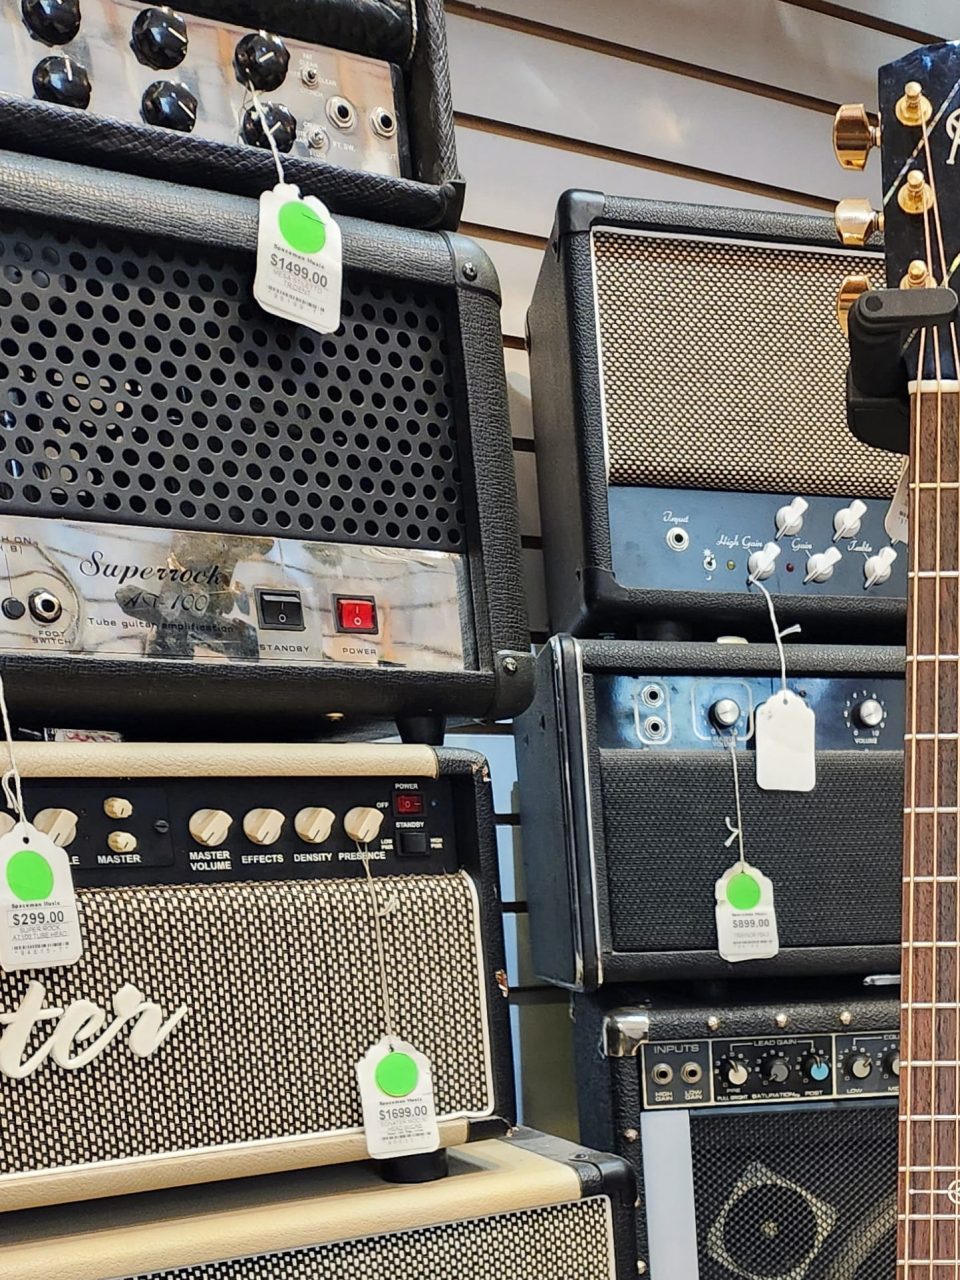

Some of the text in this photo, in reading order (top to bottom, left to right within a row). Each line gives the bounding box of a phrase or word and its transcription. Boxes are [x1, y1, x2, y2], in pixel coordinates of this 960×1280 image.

[270, 253, 328, 288] $1499.00
[717, 534, 763, 549] High Gain
[791, 537, 813, 549] Gain
[79, 550, 223, 585] Superrock
[88, 617, 235, 634] Tube guitar amplification
[38, 630, 66, 638] FOOT
[32, 637, 72, 645] SWITCH
[259, 643, 310, 653] STANDBY
[342, 647, 377, 655] POWER
[97, 854, 142, 864] MASTER
[189, 851, 231, 860] MASTER
[241, 854, 284, 864] EFFECTS
[294, 852, 333, 862] DENSITY
[338, 851, 386, 861] PRESENCE
[190, 861, 232, 871] VOLUME
[12, 911, 64, 926] $299.00
[732, 919, 769, 928] $899.00
[653, 1043, 700, 1054] INPUTS
[379, 1105, 428, 1120] $1699.00
